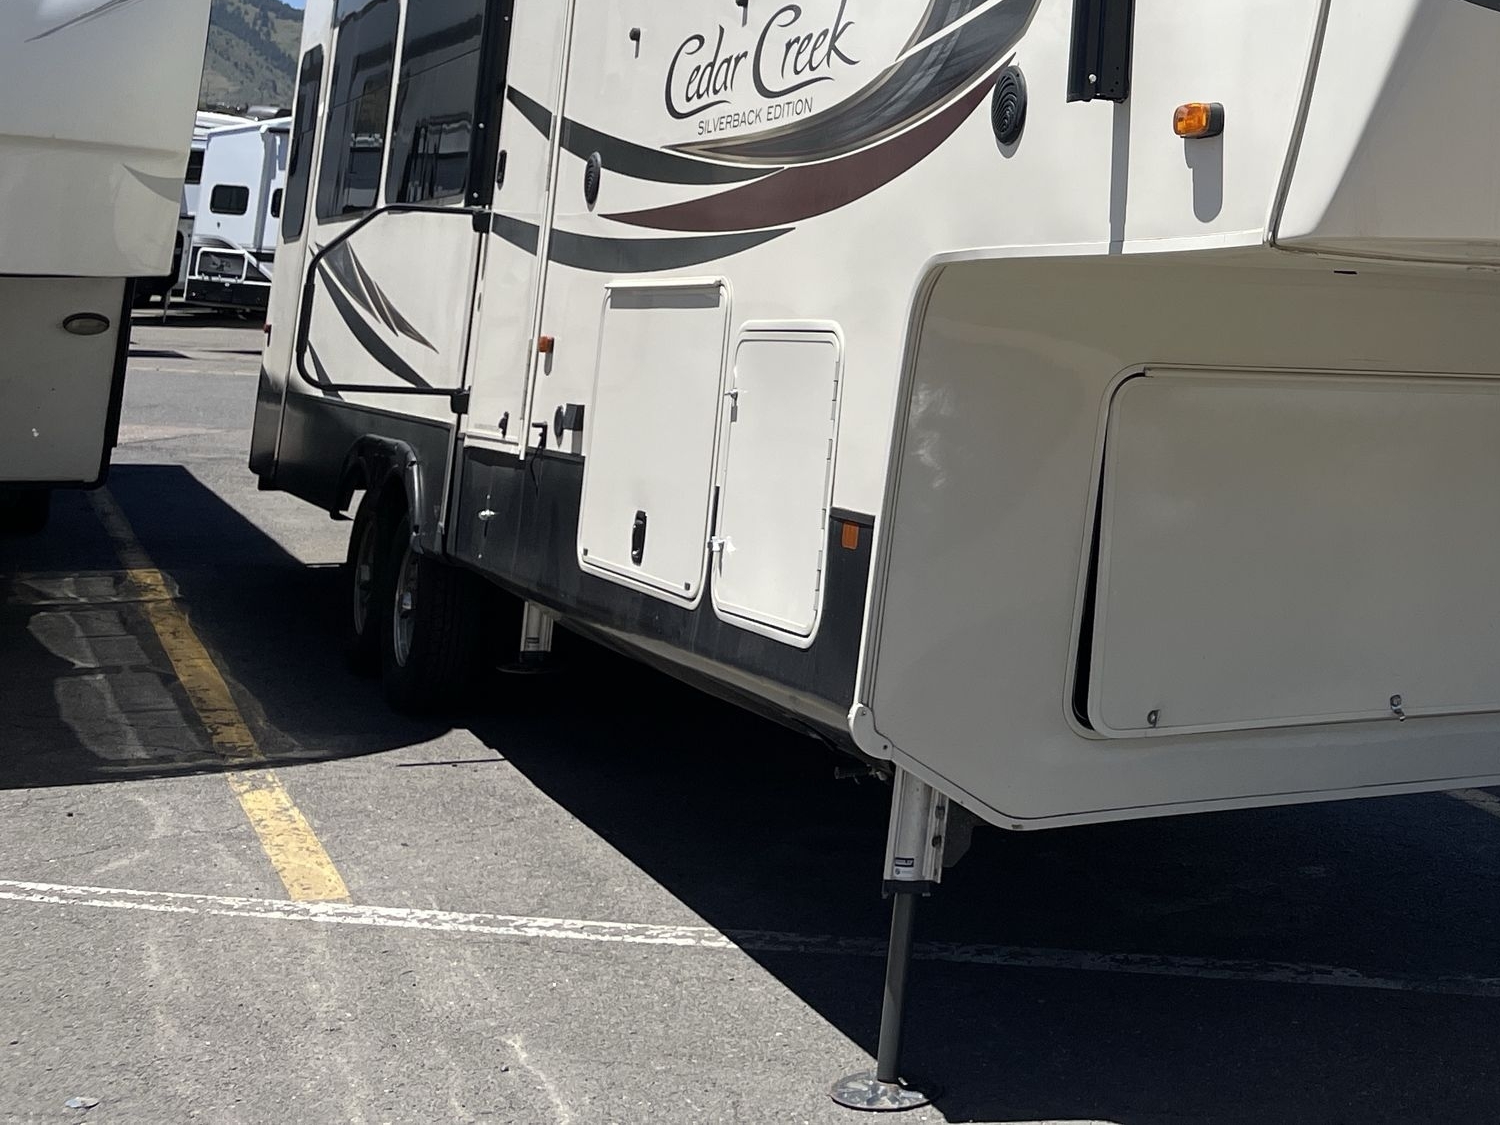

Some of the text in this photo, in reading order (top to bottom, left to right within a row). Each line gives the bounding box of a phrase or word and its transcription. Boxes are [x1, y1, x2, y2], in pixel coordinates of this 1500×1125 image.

[665, 24, 748, 119] Cedar
[697, 96, 814, 136] SILVERBACK EDITION
